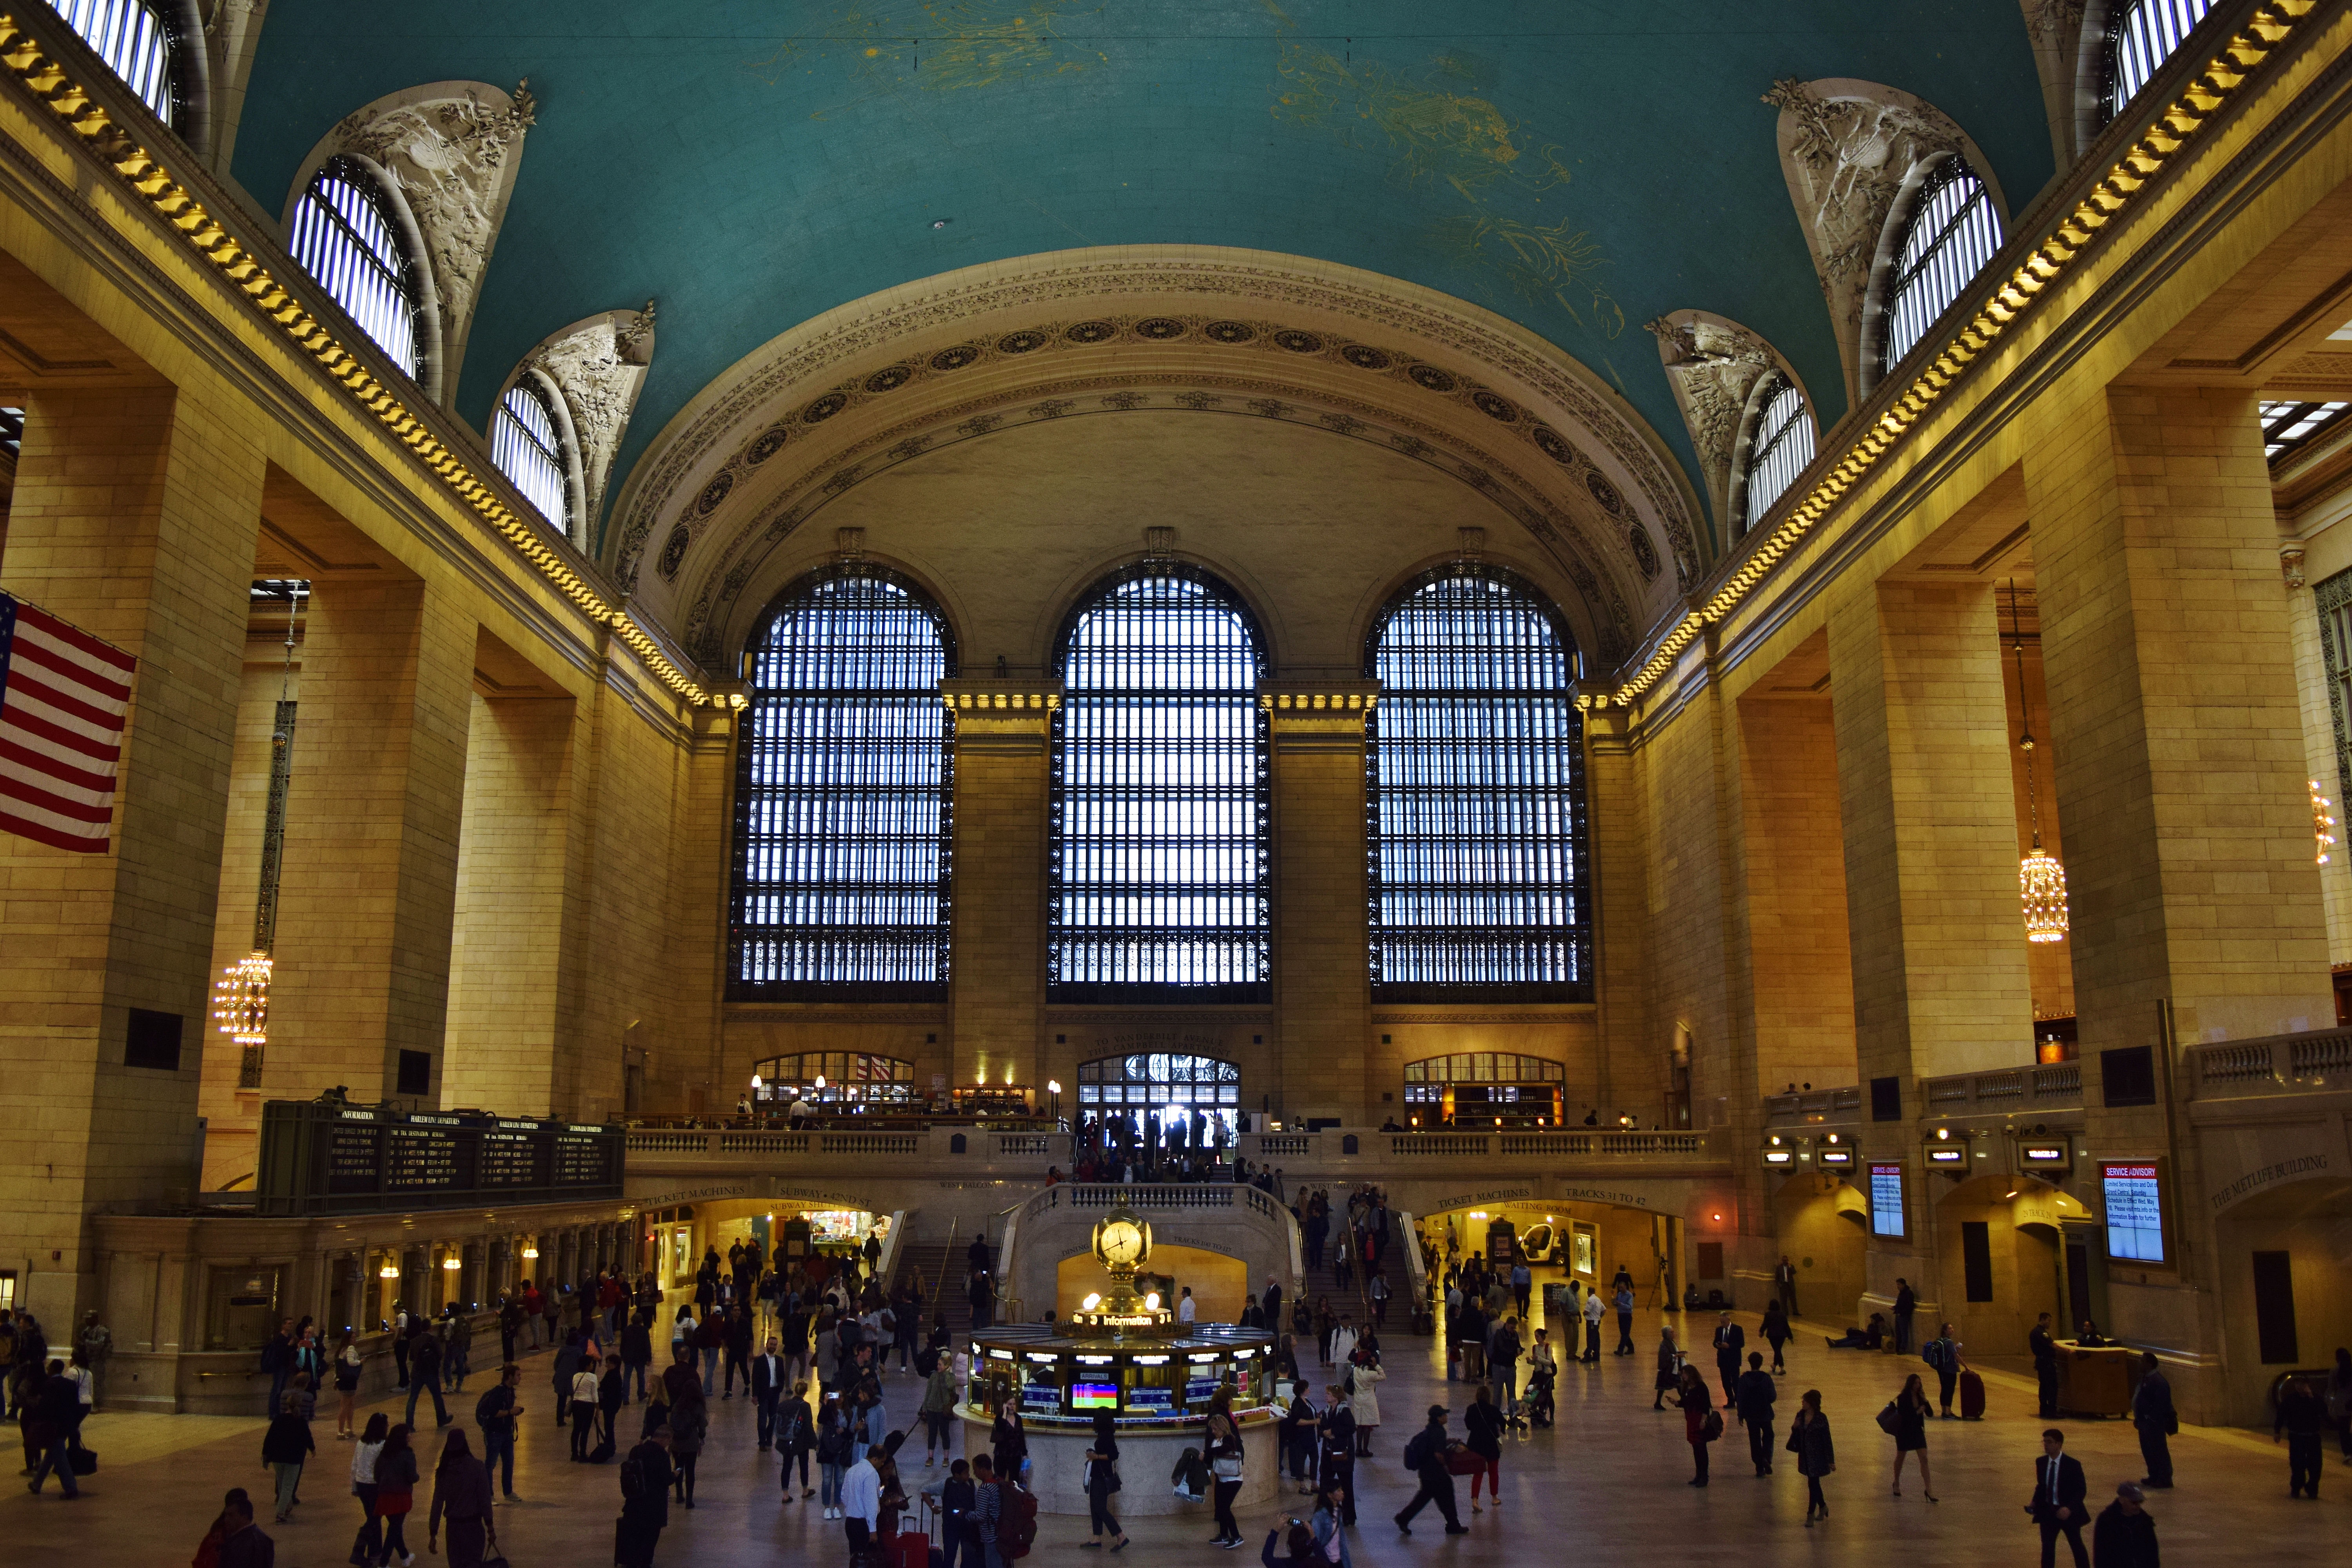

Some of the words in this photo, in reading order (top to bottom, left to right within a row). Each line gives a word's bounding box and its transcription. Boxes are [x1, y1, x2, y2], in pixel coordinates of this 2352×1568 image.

[1114, 1033, 1177, 1043] VANDERBILT
[1184, 1034, 1223, 1046] AVENUE
[1087, 1047, 1108, 1057] THE
[1113, 1042, 1164, 1051] CAMPBELL
[1173, 1043, 1231, 1057] APARTMENT
[342, 1111, 374, 1120] INFORMATION
[411, 1115, 428, 1123] HARLEM
[437, 1117, 460, 1125] DEPARTURES
[2129, 1168, 2156, 1176] ADVISORY
[2211, 1188, 2232, 1208] THE
[2231, 1167, 2273, 1197] METLIFE
[2275, 1155, 2327, 1178] BUILDING
[647, 1191, 686, 1206] TICKET
[688, 1186, 745, 1198] MACHINES
[780, 1187, 822, 1198] SUBWAY
[830, 1192, 856, 1204] 42ND
[858, 1198, 872, 1207] ST
[1438, 1195, 1472, 1208] TICKET
[1477, 1189, 1530, 1201] MACHINES
[1565, 1189, 1605, 1199] TRACKS
[1619, 1194, 1633, 1202] TO
[1636, 1197, 1646, 1205] 42
[771, 1202, 806, 1210] SUBWAY
[1504, 1201, 1542, 1211] WAITING
[1546, 1205, 1572, 1215] ROOM
[2029, 1209, 2045, 1218] TRACK
[1174, 1236, 1200, 1245] TRACKS
[1062, 1243, 1089, 1256] DINING
[1103, 1315, 1152, 1326] Information
